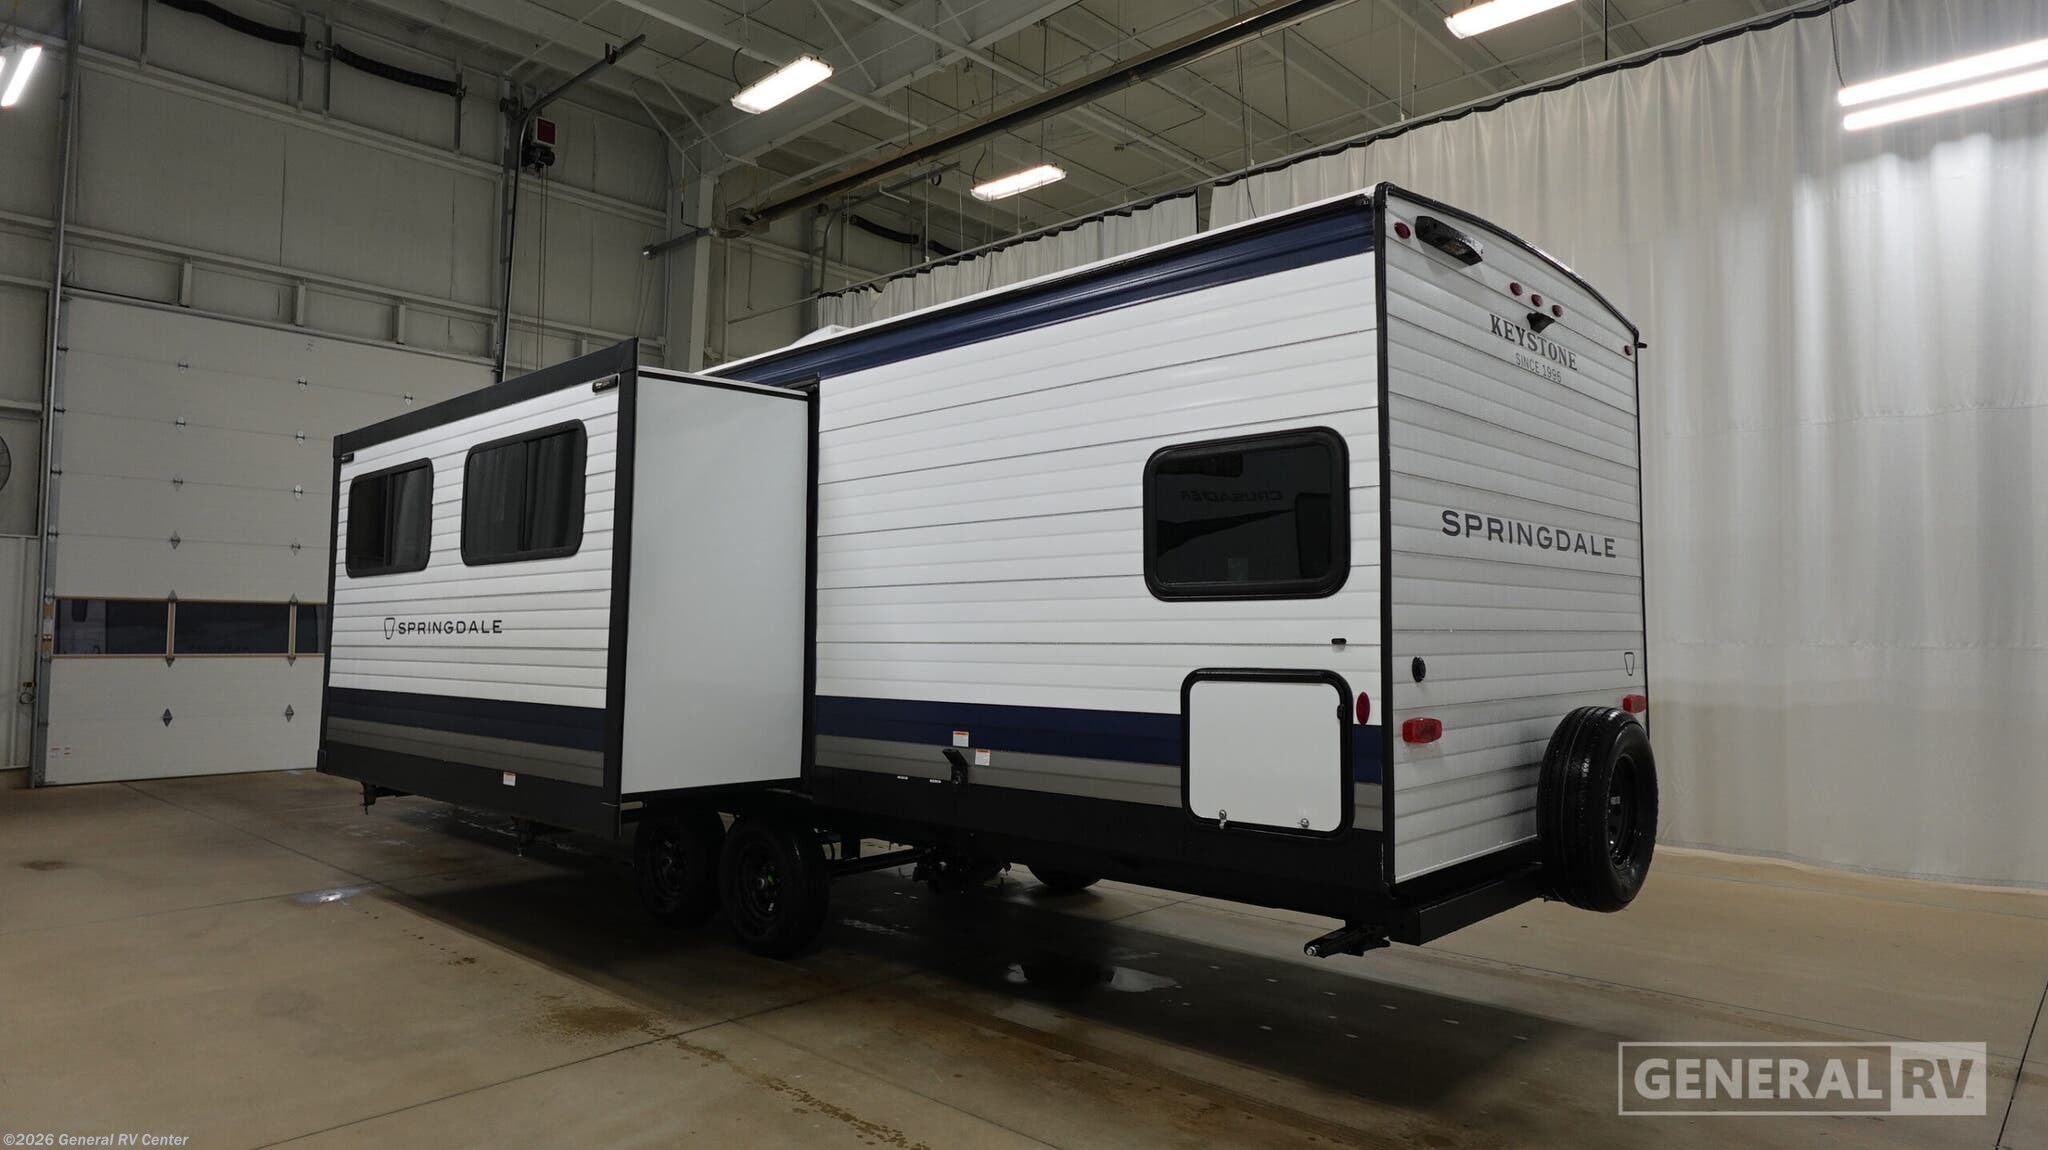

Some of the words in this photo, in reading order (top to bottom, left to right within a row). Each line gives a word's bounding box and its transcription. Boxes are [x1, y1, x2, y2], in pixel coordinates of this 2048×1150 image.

[1489, 313, 1577, 371] KEYSTONE
[1515, 352, 1540, 374] SINCE
[1441, 510, 1617, 558] SPRINGDALE
[398, 620, 503, 635] SPRINGDALE
